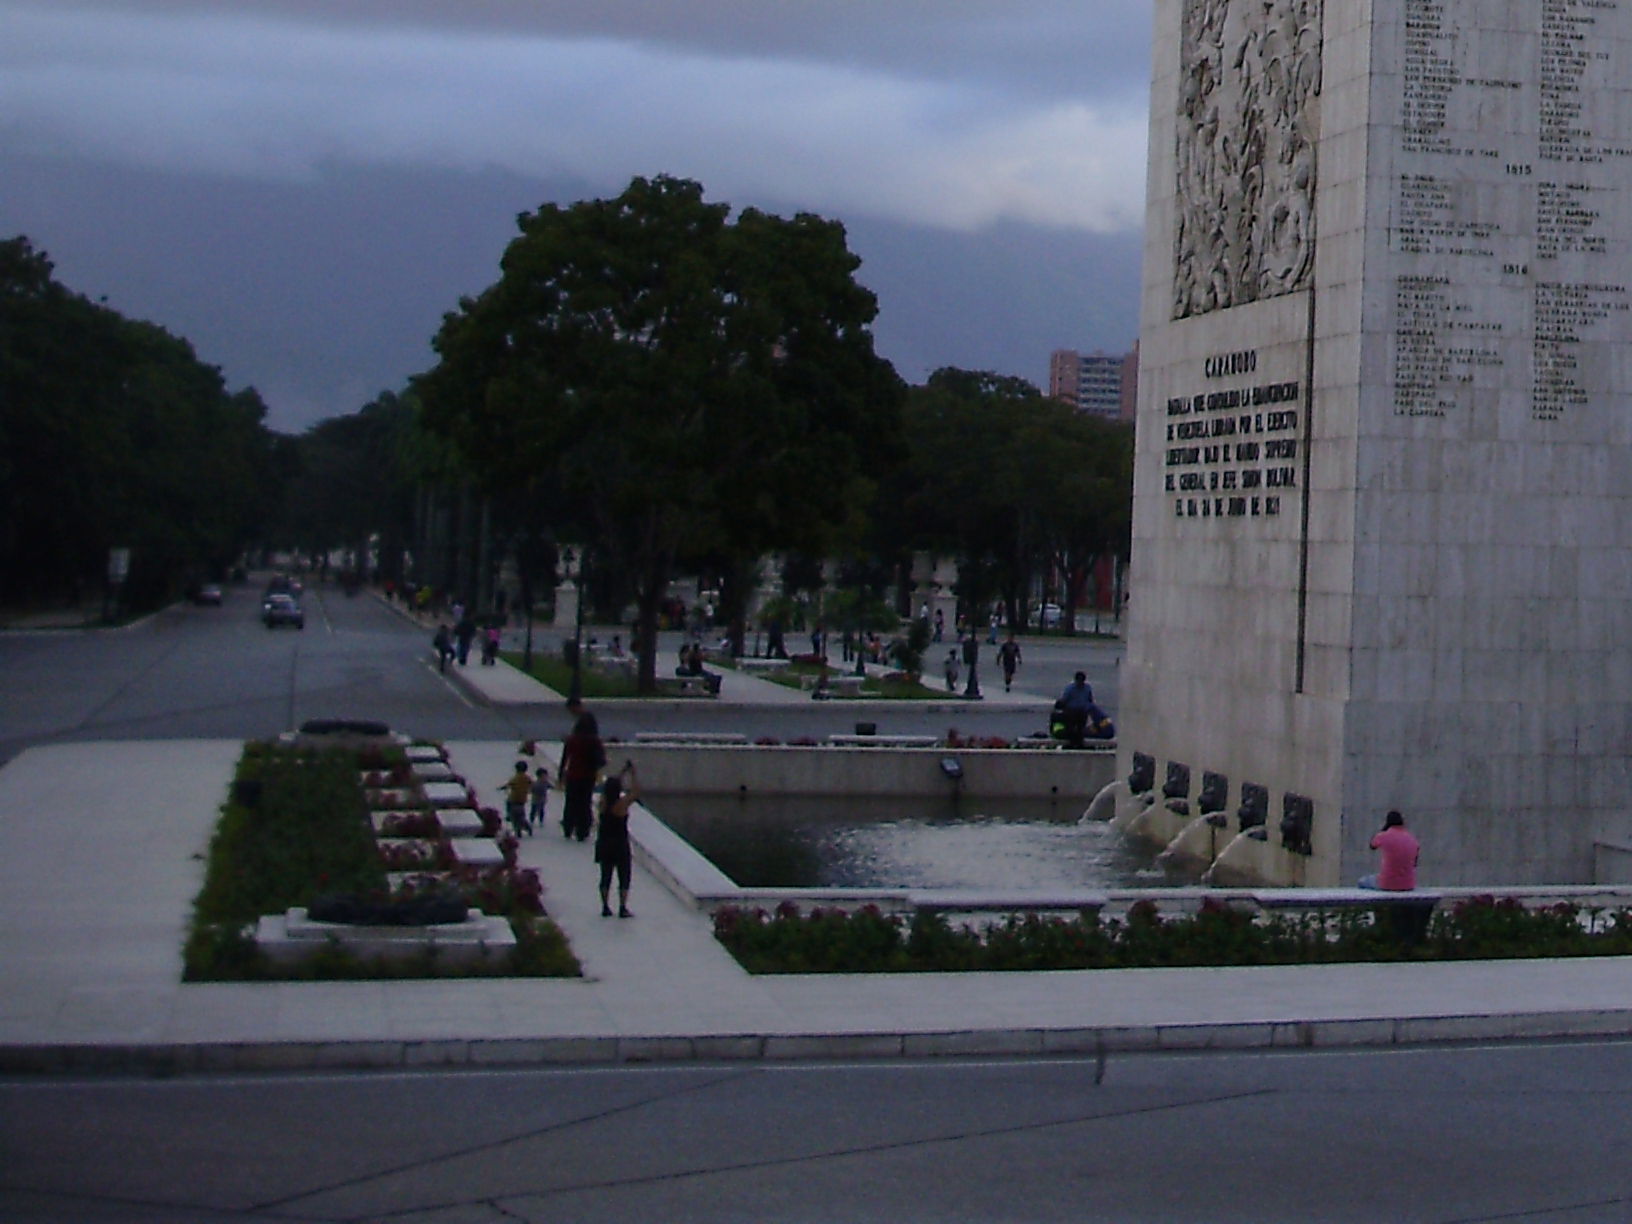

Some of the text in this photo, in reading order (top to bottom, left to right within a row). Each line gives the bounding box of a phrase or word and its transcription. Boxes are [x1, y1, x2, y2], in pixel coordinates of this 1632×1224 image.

[1205, 349, 1256, 378] CARABOBO
[1241, 389, 1250, 407] LA
[1255, 413, 1263, 433] EL
